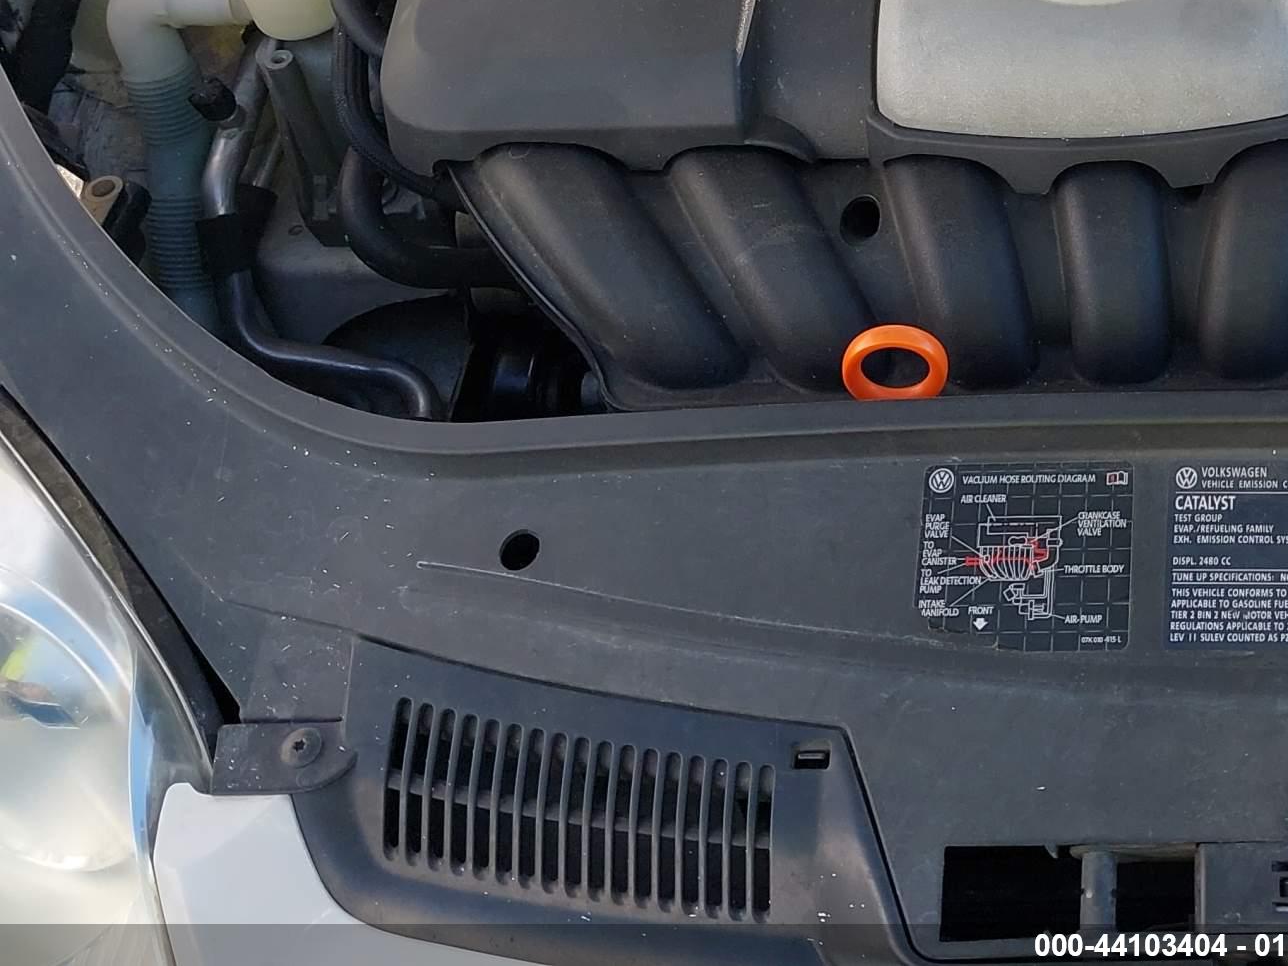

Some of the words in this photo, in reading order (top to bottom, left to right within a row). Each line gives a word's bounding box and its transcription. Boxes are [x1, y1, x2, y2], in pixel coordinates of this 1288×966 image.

[1202, 467, 1267, 478] VOLKSWAGEN
[929, 468, 954, 493] VW
[962, 476, 997, 484] VACUUM
[1021, 475, 1056, 483] ROUTING
[1176, 467, 1197, 489] VW
[1202, 481, 1233, 489] VEHICLE
[1239, 481, 1278, 489] EMISSION
[961, 495, 973, 503] AIR
[975, 495, 1006, 503] CLEANER
[1175, 495, 1236, 511] CATALYST
[926, 514, 945, 522] EVAP
[1175, 514, 1192, 522] TEST
[1195, 514, 1222, 522] GROUP
[925, 522, 949, 530] PURGE
[1078, 520, 1126, 528] VENTILATION
[1078, 528, 1101, 536] VALVE
[1246, 525, 1274, 533] FAMILY
[925, 530, 948, 538] VALVE
[1174, 535, 1192, 544] EXH.
[1197, 535, 1235, 544] EMISSION
[1238, 535, 1274, 544] CONTROL
[923, 549, 942, 557] EVAP
[922, 557, 956, 565] CANISTER
[1173, 557, 1197, 565] DISPL.
[1200, 557, 1219, 565] 2480
[1221, 557, 1231, 565] CC
[1064, 565, 1100, 573] THROTTLE
[921, 577, 938, 585] LEAK
[1172, 573, 1193, 582] TUNE
[1196, 573, 1207, 582] UP
[1210, 573, 1274, 582] SPECIFICATIONS:
[1172, 589, 1190, 597] THIS
[1192, 589, 1225, 597] VEHICLE
[1228, 589, 1273, 597] CONFORMS
[1276, 589, 1287, 597] TO
[919, 600, 945, 608] INTAKE
[1171, 600, 1216, 608] APPLICABLE
[1219, 600, 1229, 608] TO
[1232, 600, 1271, 608] GASOLINE
[968, 606, 994, 615] FRONT
[1171, 611, 1188, 619] TIER
[1190, 611, 1195, 619] 2
[1198, 611, 1211, 619] BIN
[1214, 611, 1218, 619] 2
[1221, 611, 1240, 619] NEW
[1171, 622, 1224, 630] REGULATIONS
[1226, 622, 1271, 630] APPLICABLE
[1274, 622, 1284, 630] TO
[1170, 633, 1184, 642] LEV
[1200, 633, 1224, 642] SULEV
[1227, 633, 1265, 642] COUNTED
[1268, 634, 1278, 642] AS
